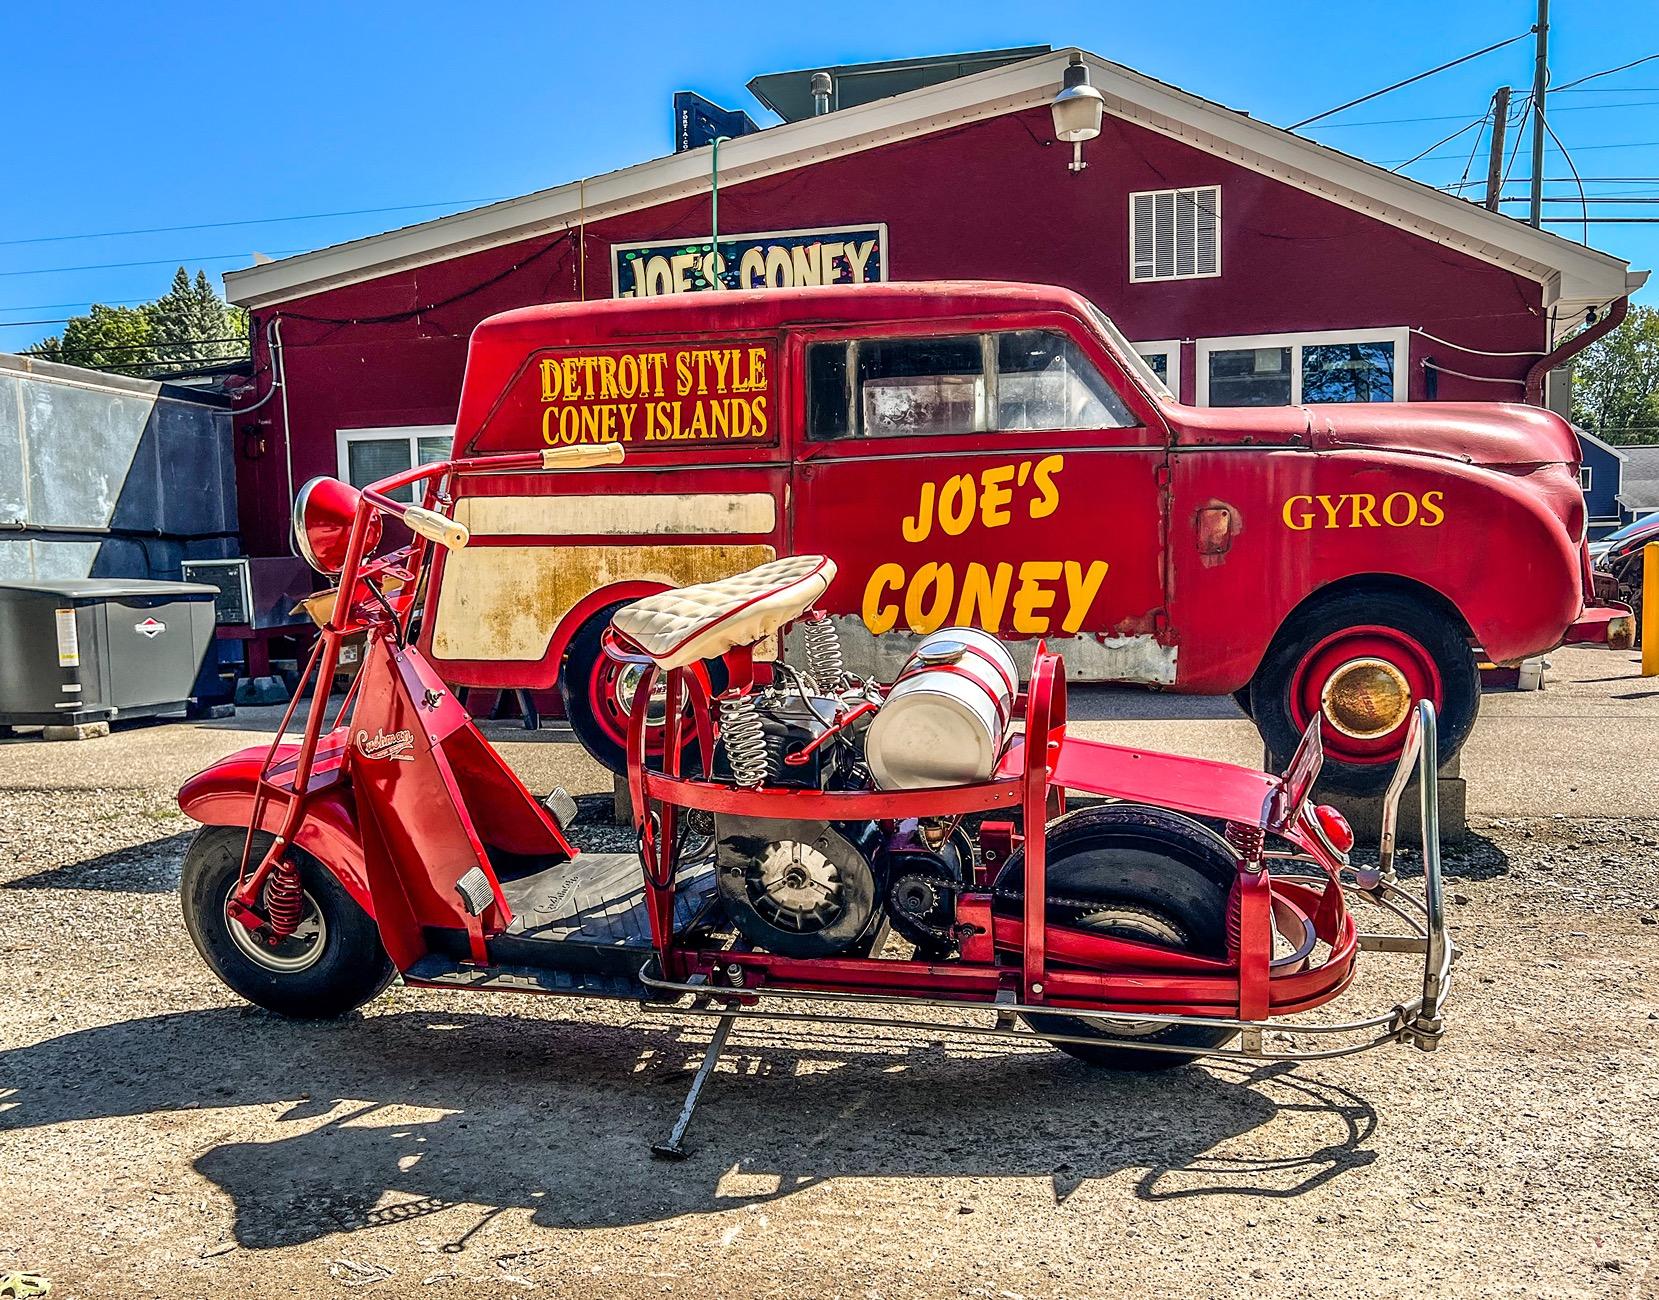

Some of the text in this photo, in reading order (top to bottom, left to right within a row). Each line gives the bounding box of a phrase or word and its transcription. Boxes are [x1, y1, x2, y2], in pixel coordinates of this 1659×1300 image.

[740, 240, 876, 290] CONEY
[540, 347, 768, 402] DETROIT STYLE
[542, 396, 768, 445] CONEY ISLANDS
[902, 454, 1064, 543] JOE'S
[1282, 490, 1445, 531] GYROS
[862, 560, 1109, 635] CONEY
[356, 727, 414, 760] Cushman
